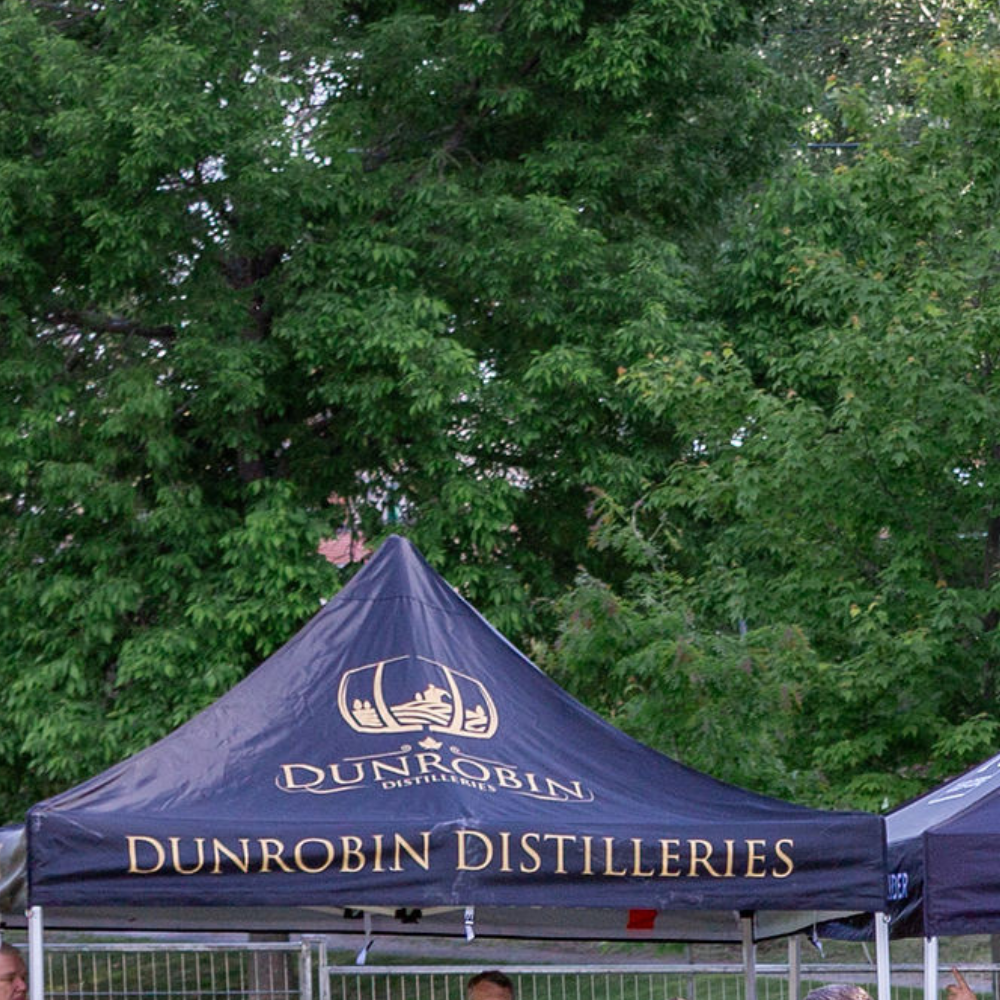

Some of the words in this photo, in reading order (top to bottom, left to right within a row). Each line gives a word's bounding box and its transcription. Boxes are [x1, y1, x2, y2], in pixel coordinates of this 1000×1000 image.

[277, 751, 592, 802] DUNROBIN
[381, 773, 498, 793] DISTILLERIES
[125, 830, 432, 875] DUNROBIN
[454, 829, 796, 879] DISTILLERIES
